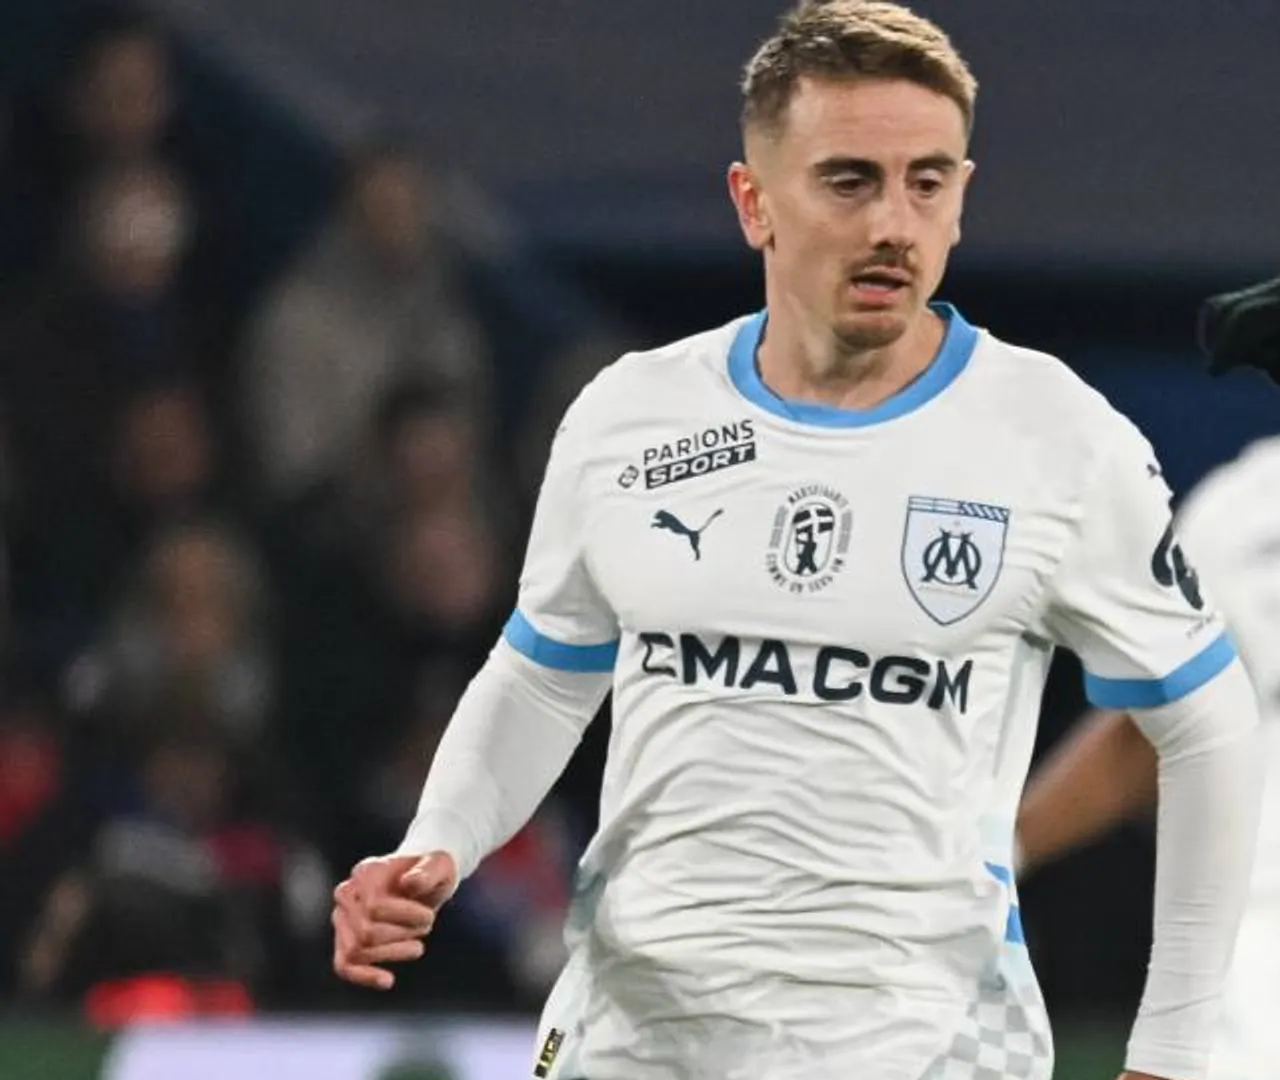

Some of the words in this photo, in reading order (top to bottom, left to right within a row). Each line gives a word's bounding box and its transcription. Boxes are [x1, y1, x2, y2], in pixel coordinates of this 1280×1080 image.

[643, 419, 754, 465] PARIONS
[648, 445, 751, 488] SPORT
[638, 631, 798, 695] CMA
[813, 645, 974, 714] CGM
